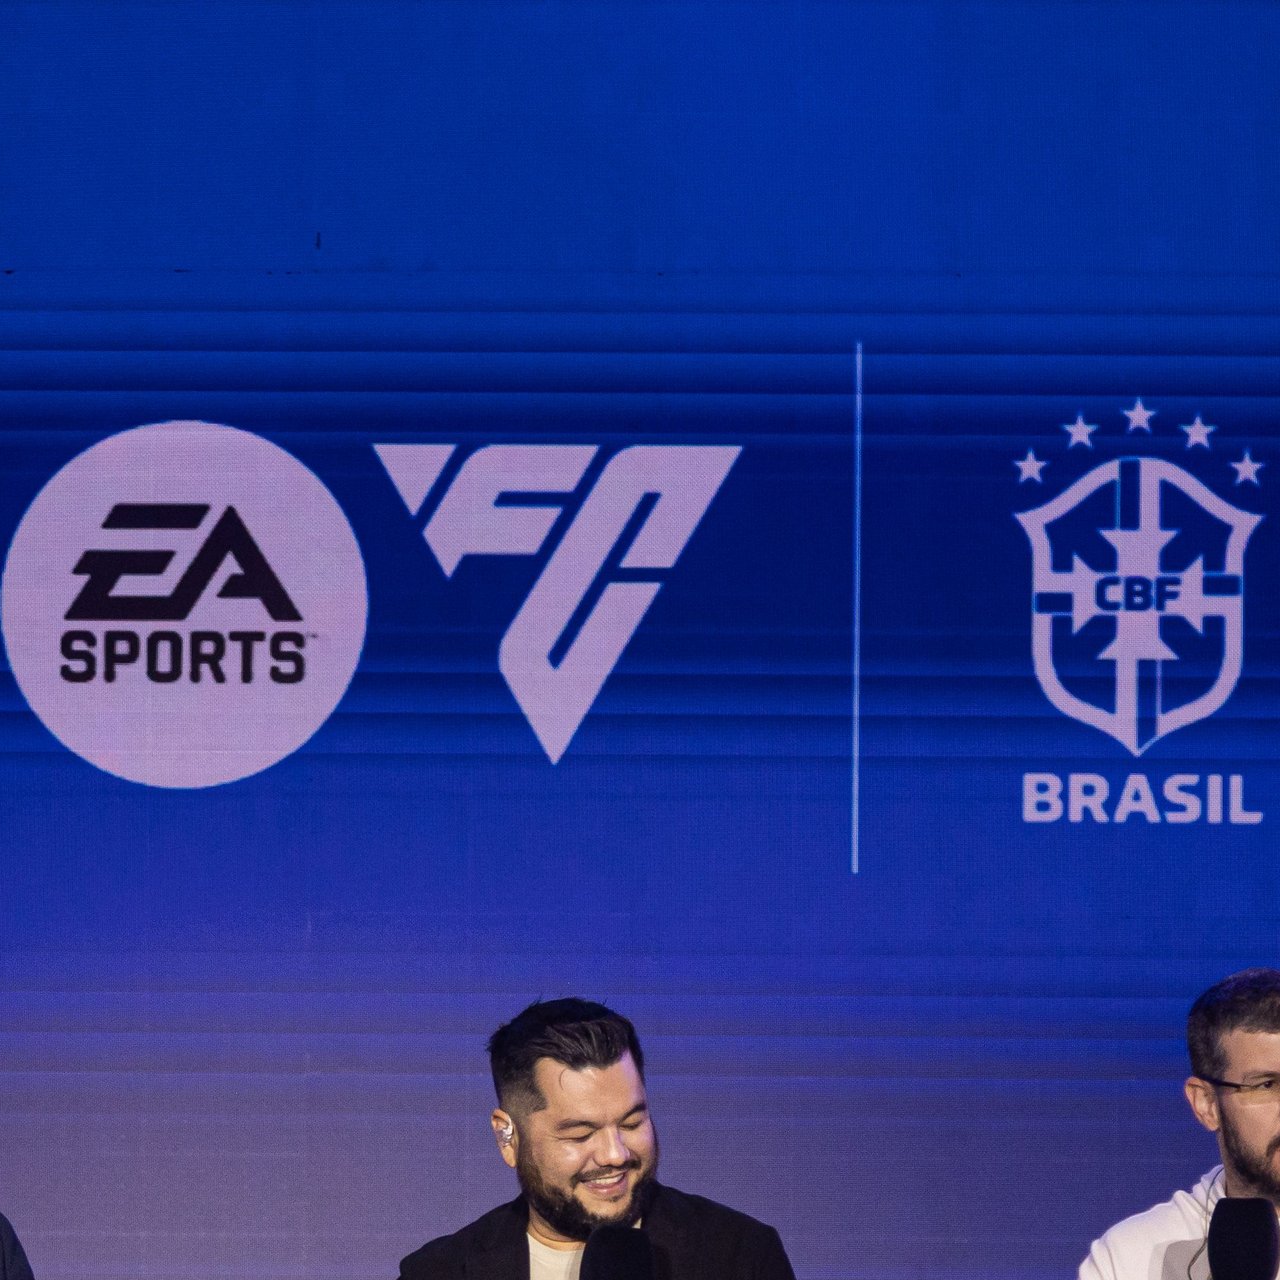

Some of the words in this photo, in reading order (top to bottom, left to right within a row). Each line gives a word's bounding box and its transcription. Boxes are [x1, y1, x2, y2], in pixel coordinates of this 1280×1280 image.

[64, 502, 303, 621] EA
[1095, 575, 1182, 612] CBF
[60, 629, 306, 684] SPORTS
[1022, 773, 1263, 824] BRASIL
